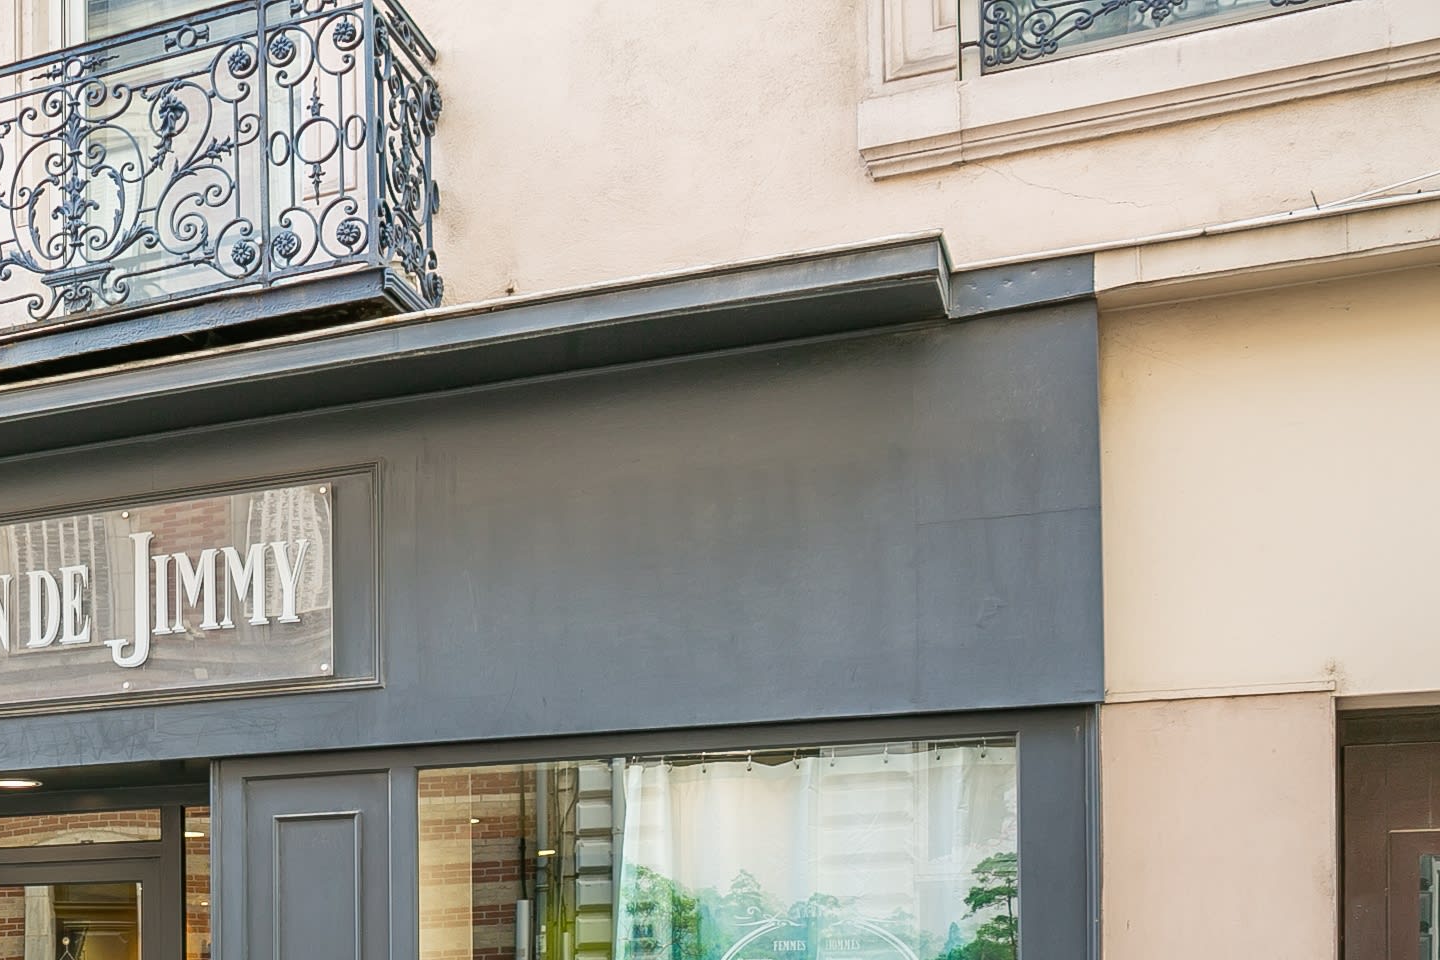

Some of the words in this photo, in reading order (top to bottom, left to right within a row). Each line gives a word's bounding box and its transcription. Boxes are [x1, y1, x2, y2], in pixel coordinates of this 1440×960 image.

[26, 564, 91, 648] DE
[104, 531, 311, 669] JIMMY
[773, 940, 806, 951] FEMMES
